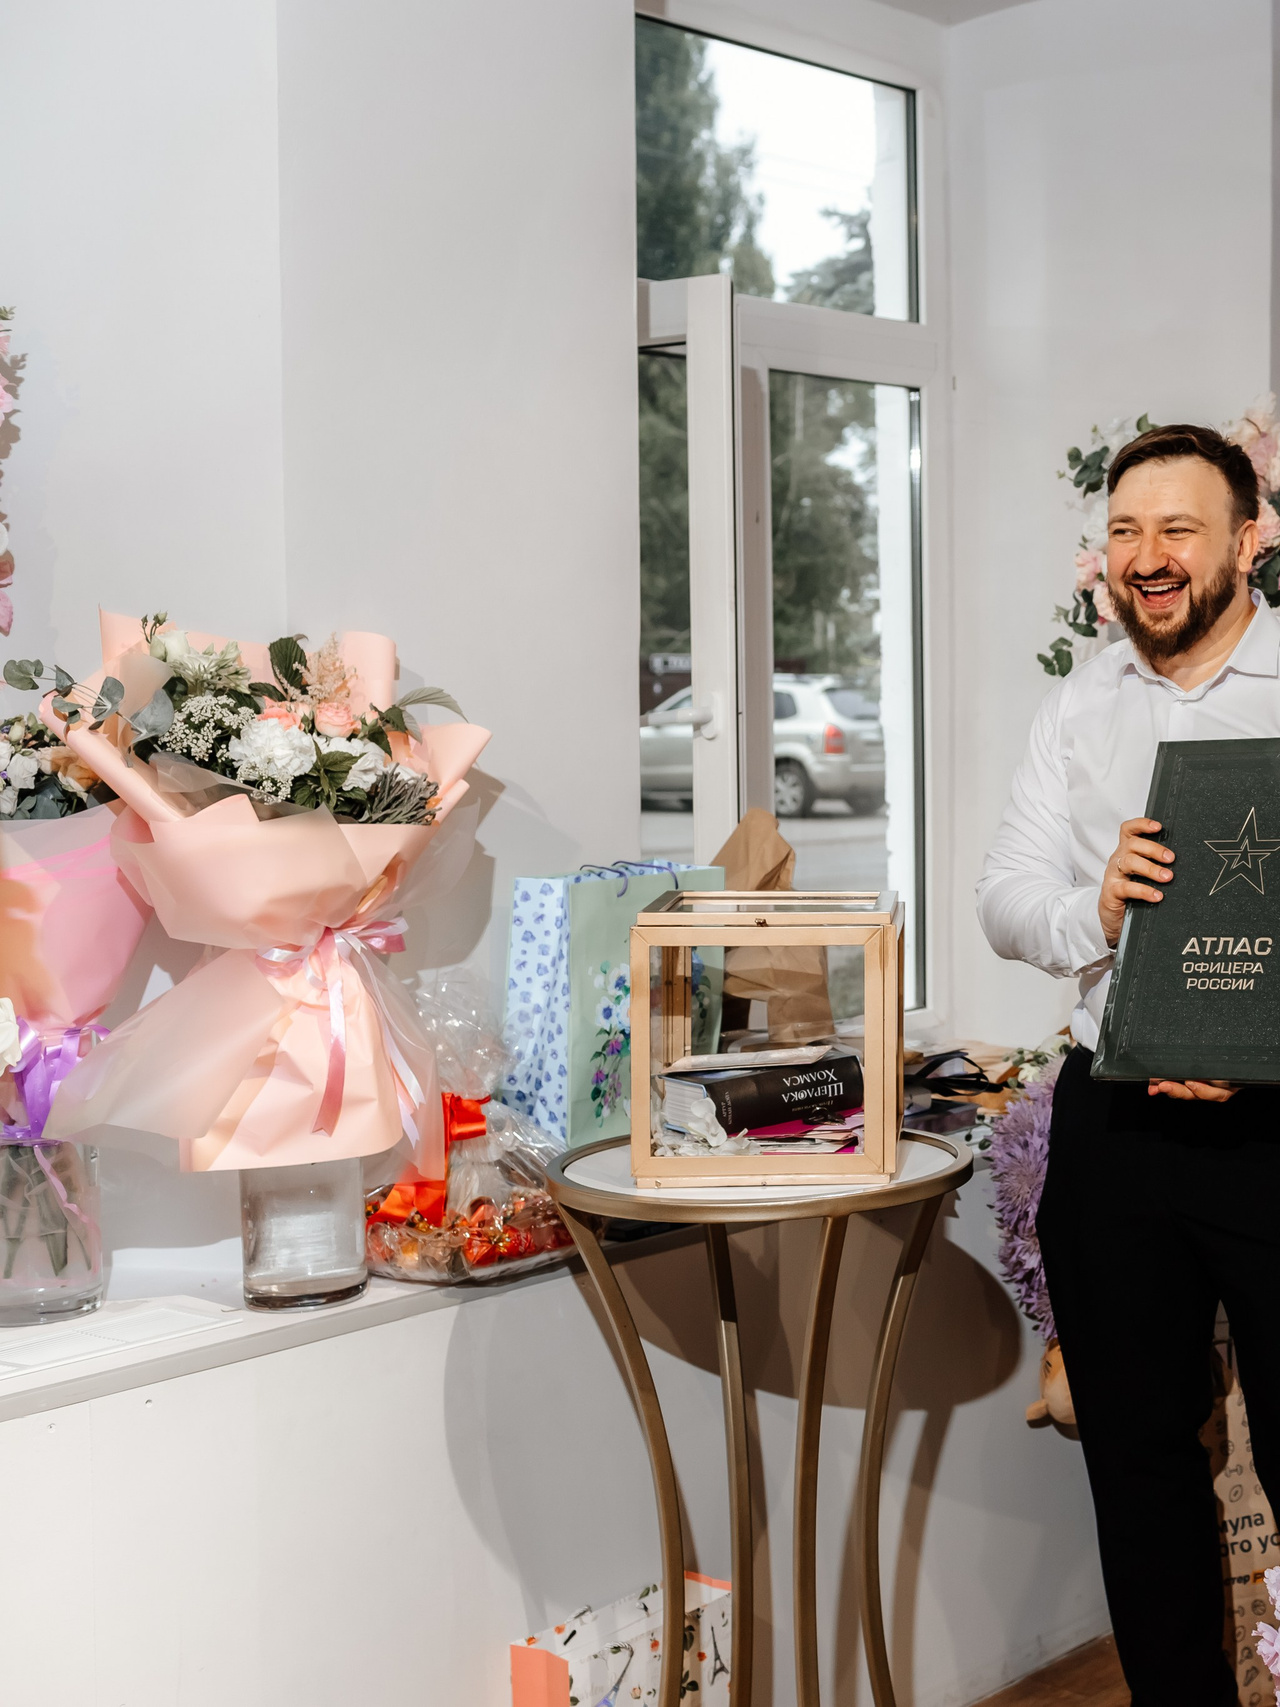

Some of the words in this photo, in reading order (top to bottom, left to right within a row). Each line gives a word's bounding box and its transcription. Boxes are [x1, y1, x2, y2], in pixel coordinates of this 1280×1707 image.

[1181, 936, 1273, 956] АТЛАС
[1182, 961, 1265, 975] ОФИЦЕРА
[1186, 978, 1255, 991] РОССИИ
